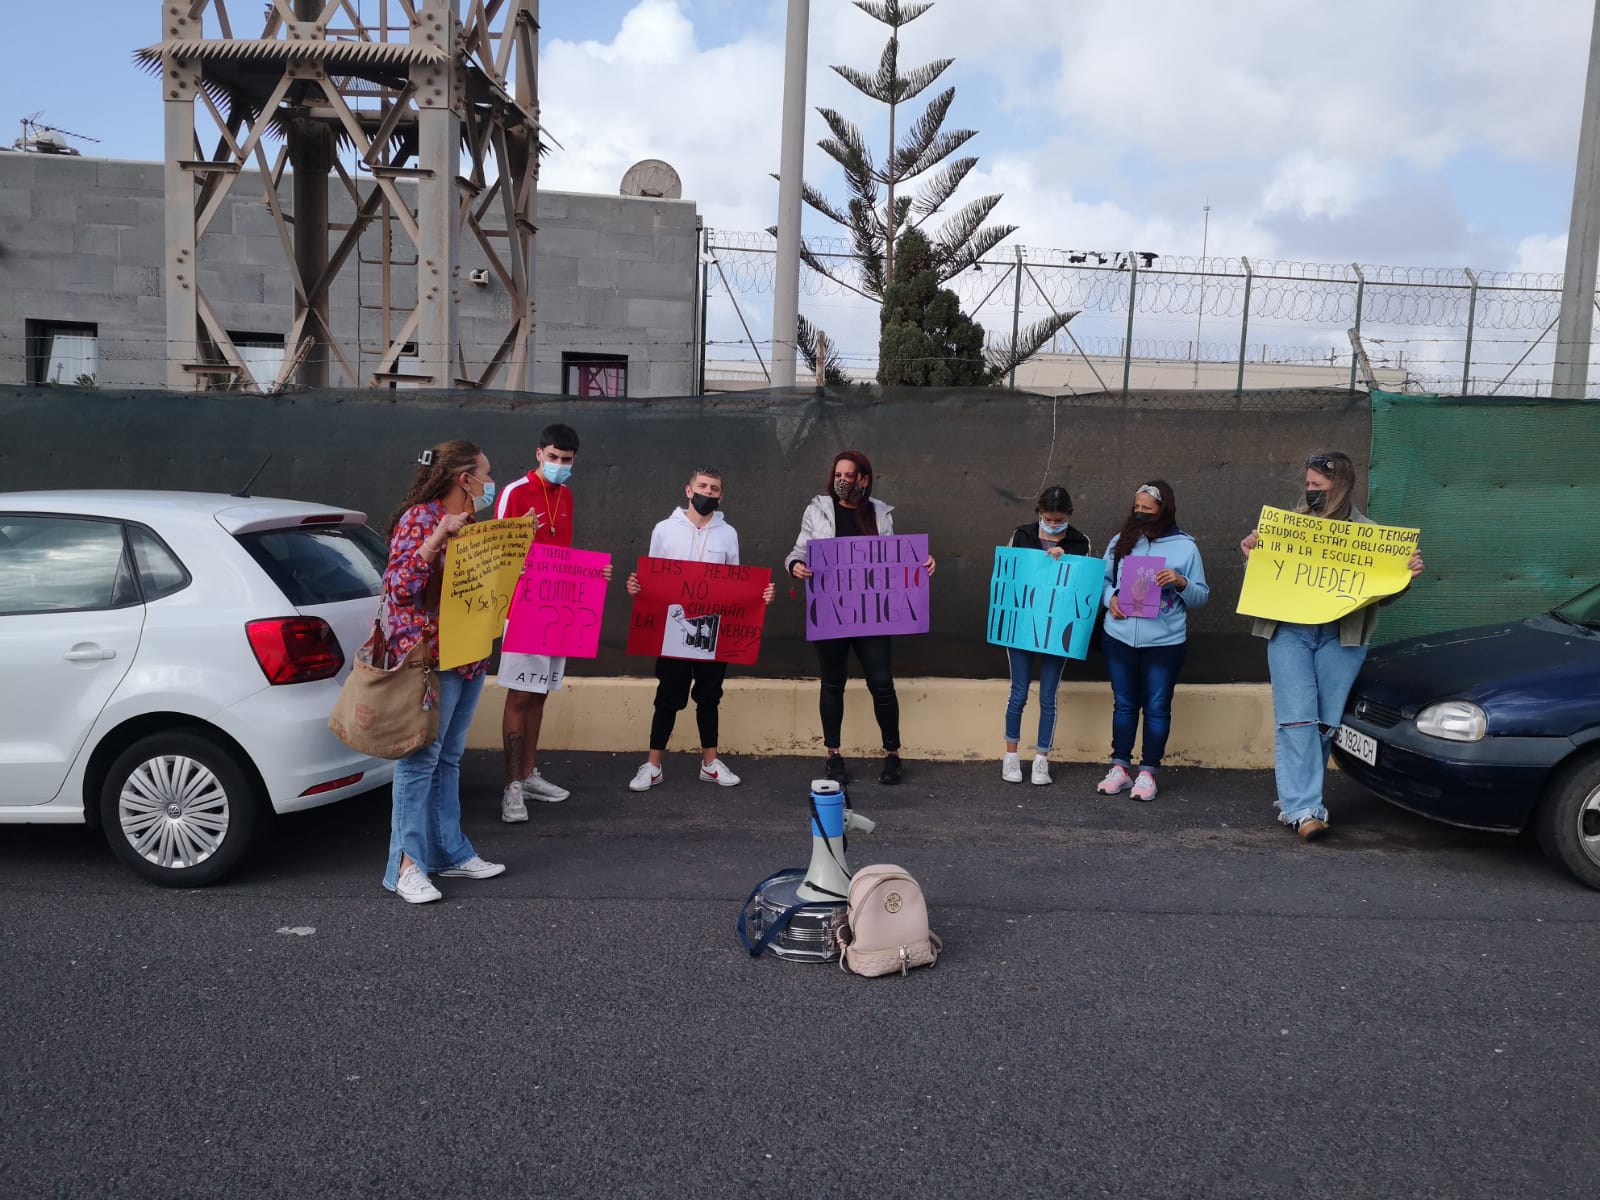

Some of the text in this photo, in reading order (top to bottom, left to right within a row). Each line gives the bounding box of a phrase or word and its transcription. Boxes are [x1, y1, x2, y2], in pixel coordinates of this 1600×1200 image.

[1262, 509, 1419, 544] LOS PRESOS QUE NO TENGAN
[1256, 539, 1265, 550] A
[1270, 541, 1281, 551] IR
[1286, 543, 1294, 553] A
[1298, 546, 1313, 557] LA
[1352, 539, 1412, 557] OBLIGADOS
[537, 562, 549, 572] LA
[650, 558, 752, 581] LAS REJAS
[1273, 559, 1366, 595] Y PUEDEN
[539, 579, 586, 604] CUMPLE
[681, 579, 709, 601] NO
[634, 612, 655, 628] LA
[810, 592, 919, 629] CASTIGA
[515, 672, 563, 686] ATHE
[1345, 728, 1362, 755] 1924
